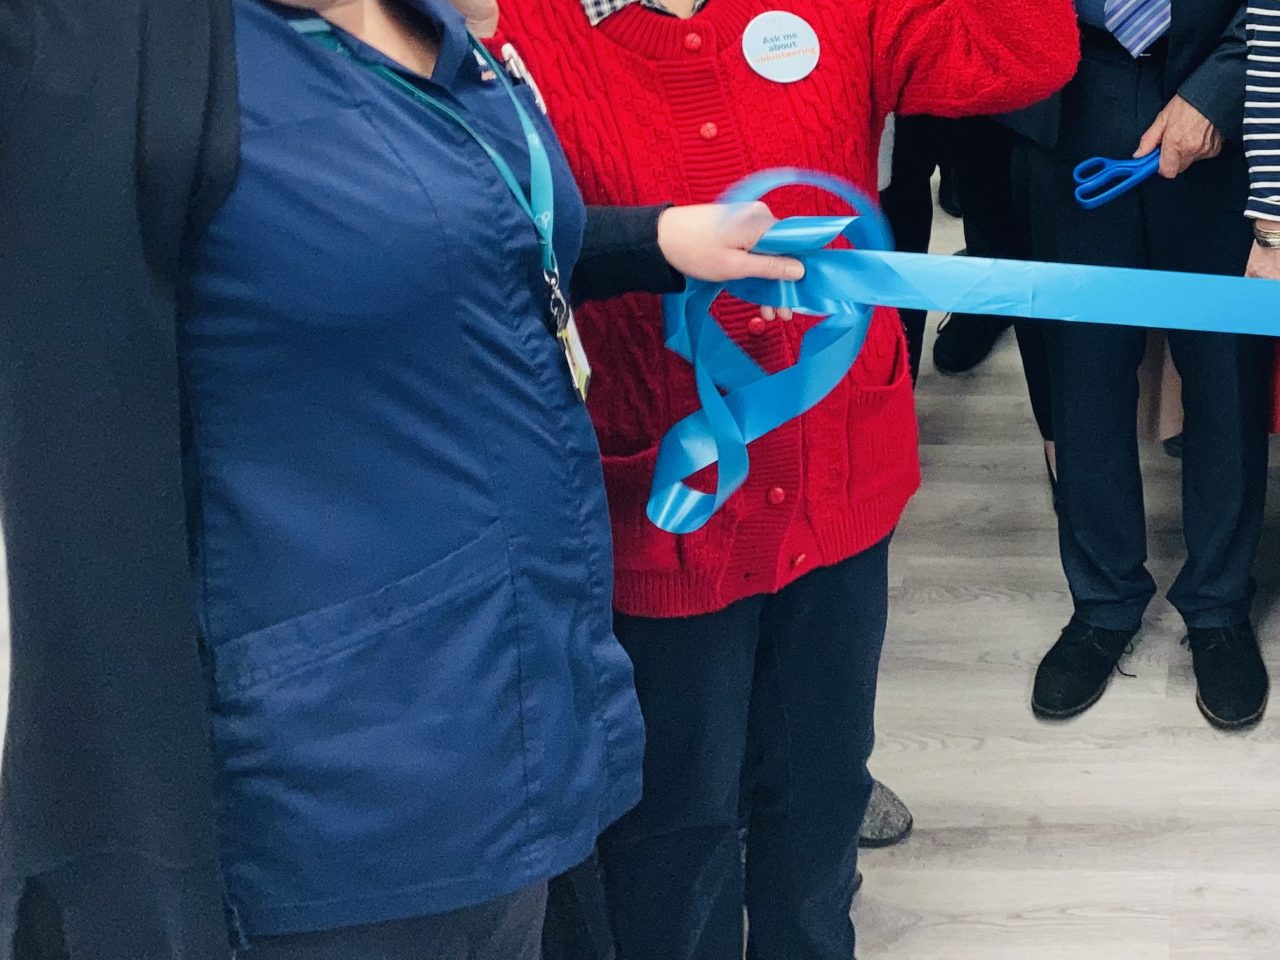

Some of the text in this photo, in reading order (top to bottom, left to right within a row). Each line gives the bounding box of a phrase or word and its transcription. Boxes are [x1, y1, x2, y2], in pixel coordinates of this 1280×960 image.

[763, 33, 798, 44] Ask me
[768, 41, 798, 52] about
